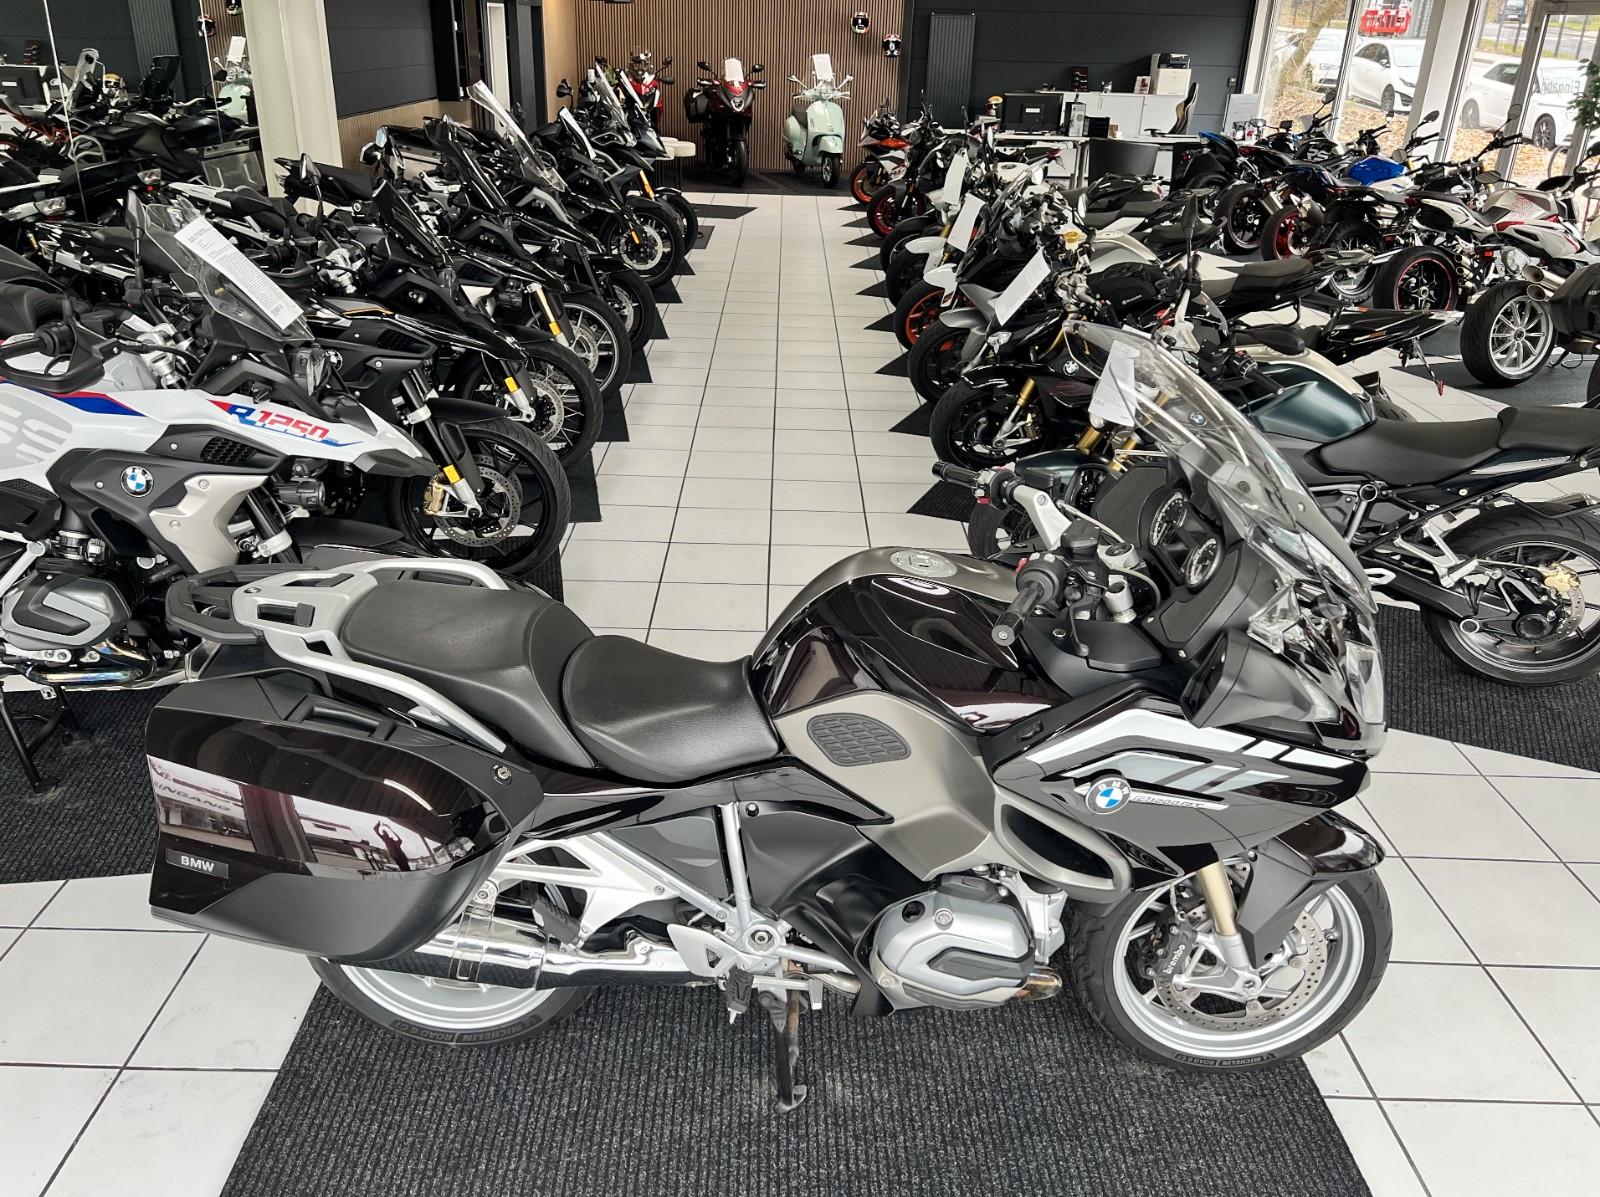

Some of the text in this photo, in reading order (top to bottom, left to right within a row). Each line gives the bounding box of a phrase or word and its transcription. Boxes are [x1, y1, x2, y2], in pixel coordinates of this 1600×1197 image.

[180, 855, 215, 873] BMW
[1162, 944, 1186, 974] brembo
[462, 1024, 523, 1042] MICHELIN
